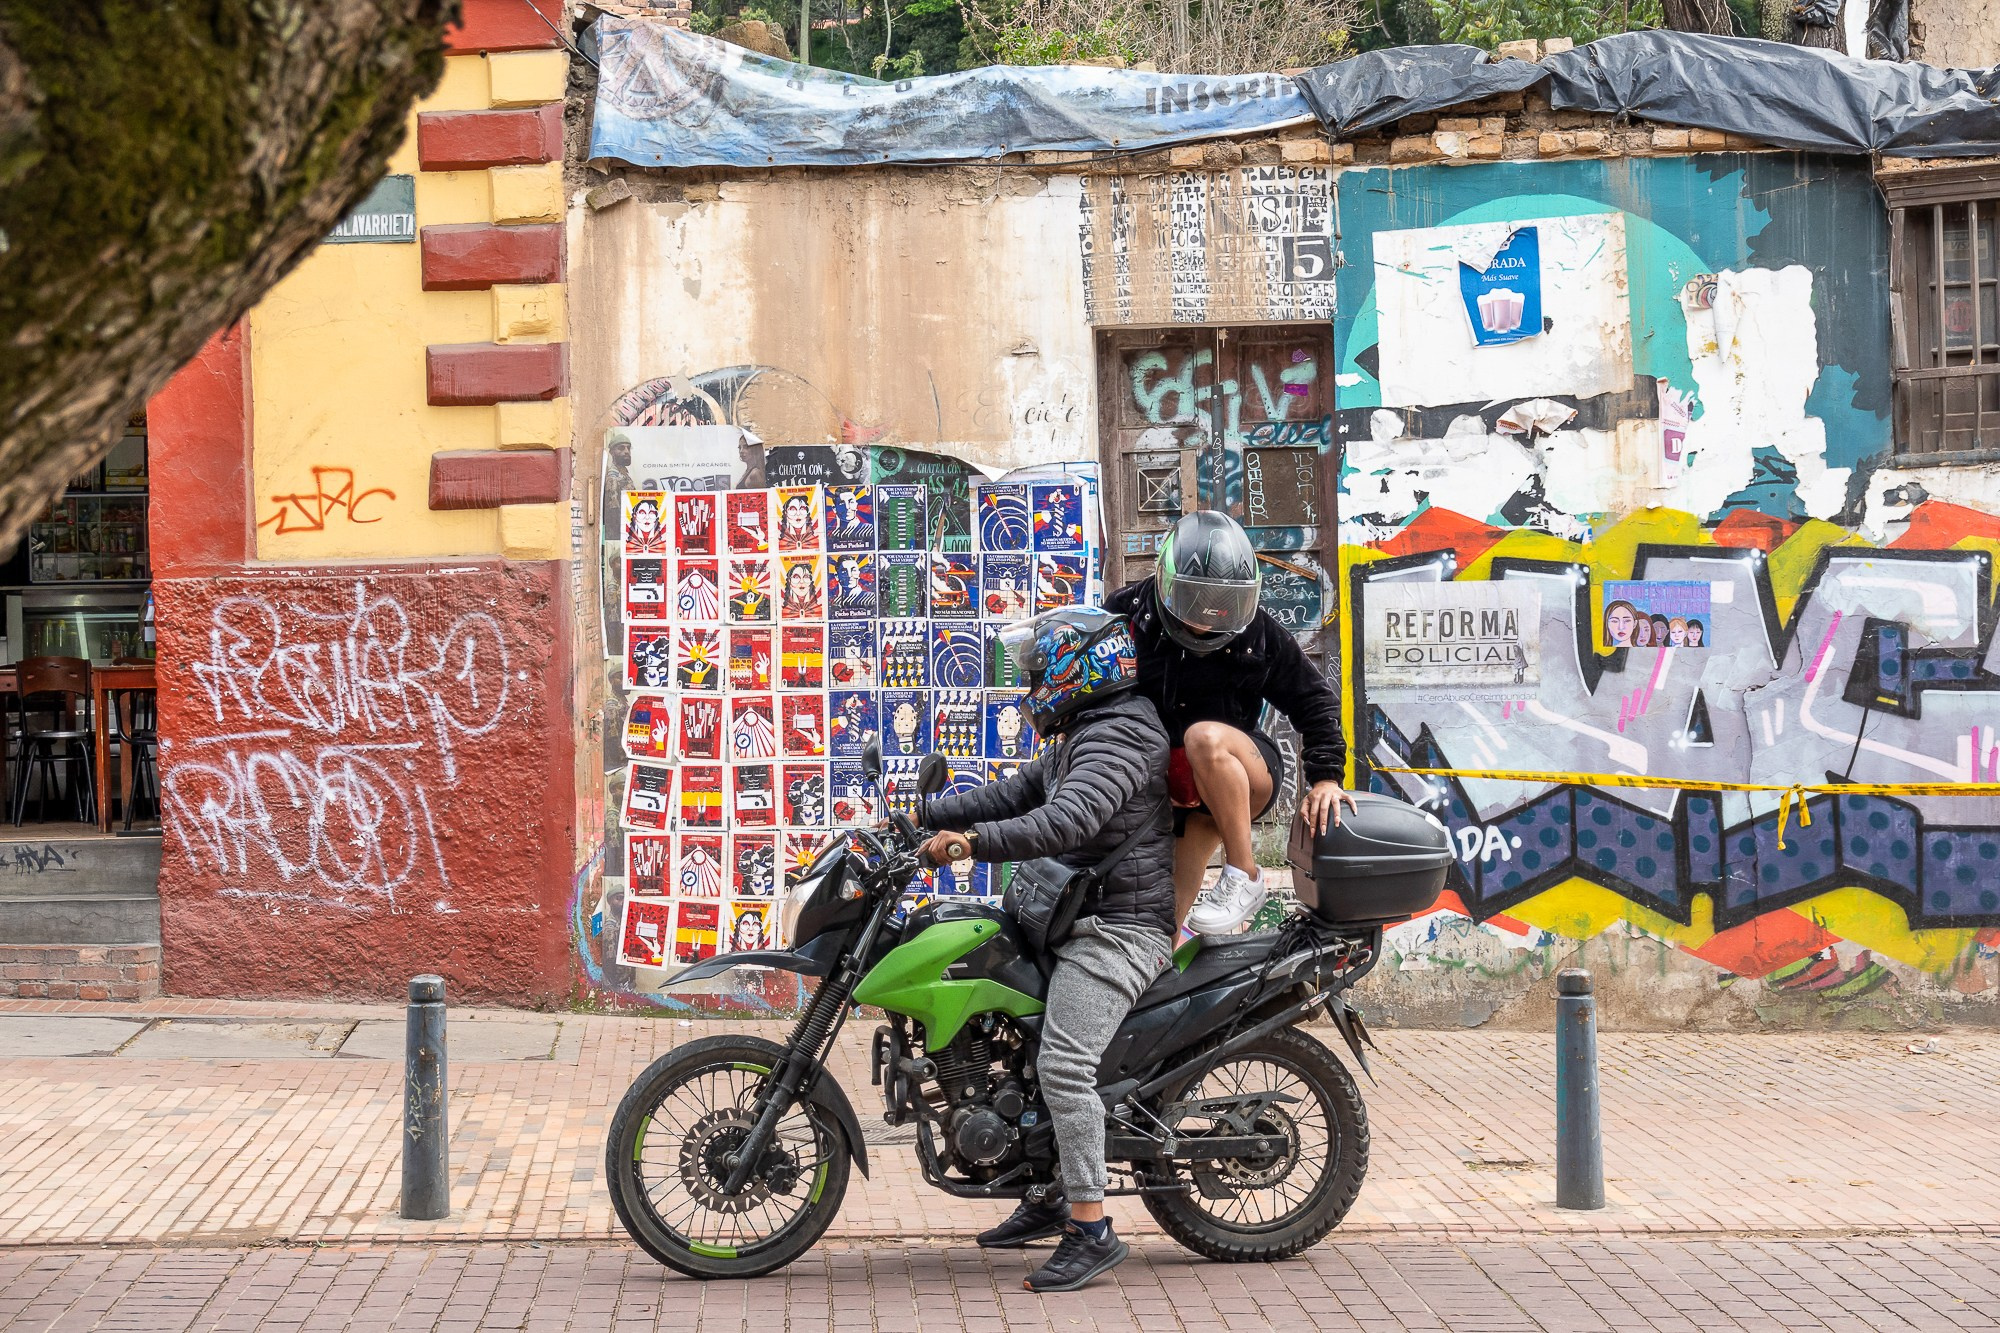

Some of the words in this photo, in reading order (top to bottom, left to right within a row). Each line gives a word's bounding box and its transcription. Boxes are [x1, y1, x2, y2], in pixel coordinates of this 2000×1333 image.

[329, 214, 414, 237] ALAVARRIETA
[1498, 273, 1519, 281] Suave
[779, 463, 807, 476] CHATEA
[917, 463, 945, 474] CHATEA
[1386, 609, 1518, 639] REFORMA
[1386, 646, 1516, 663] POLICIAL
